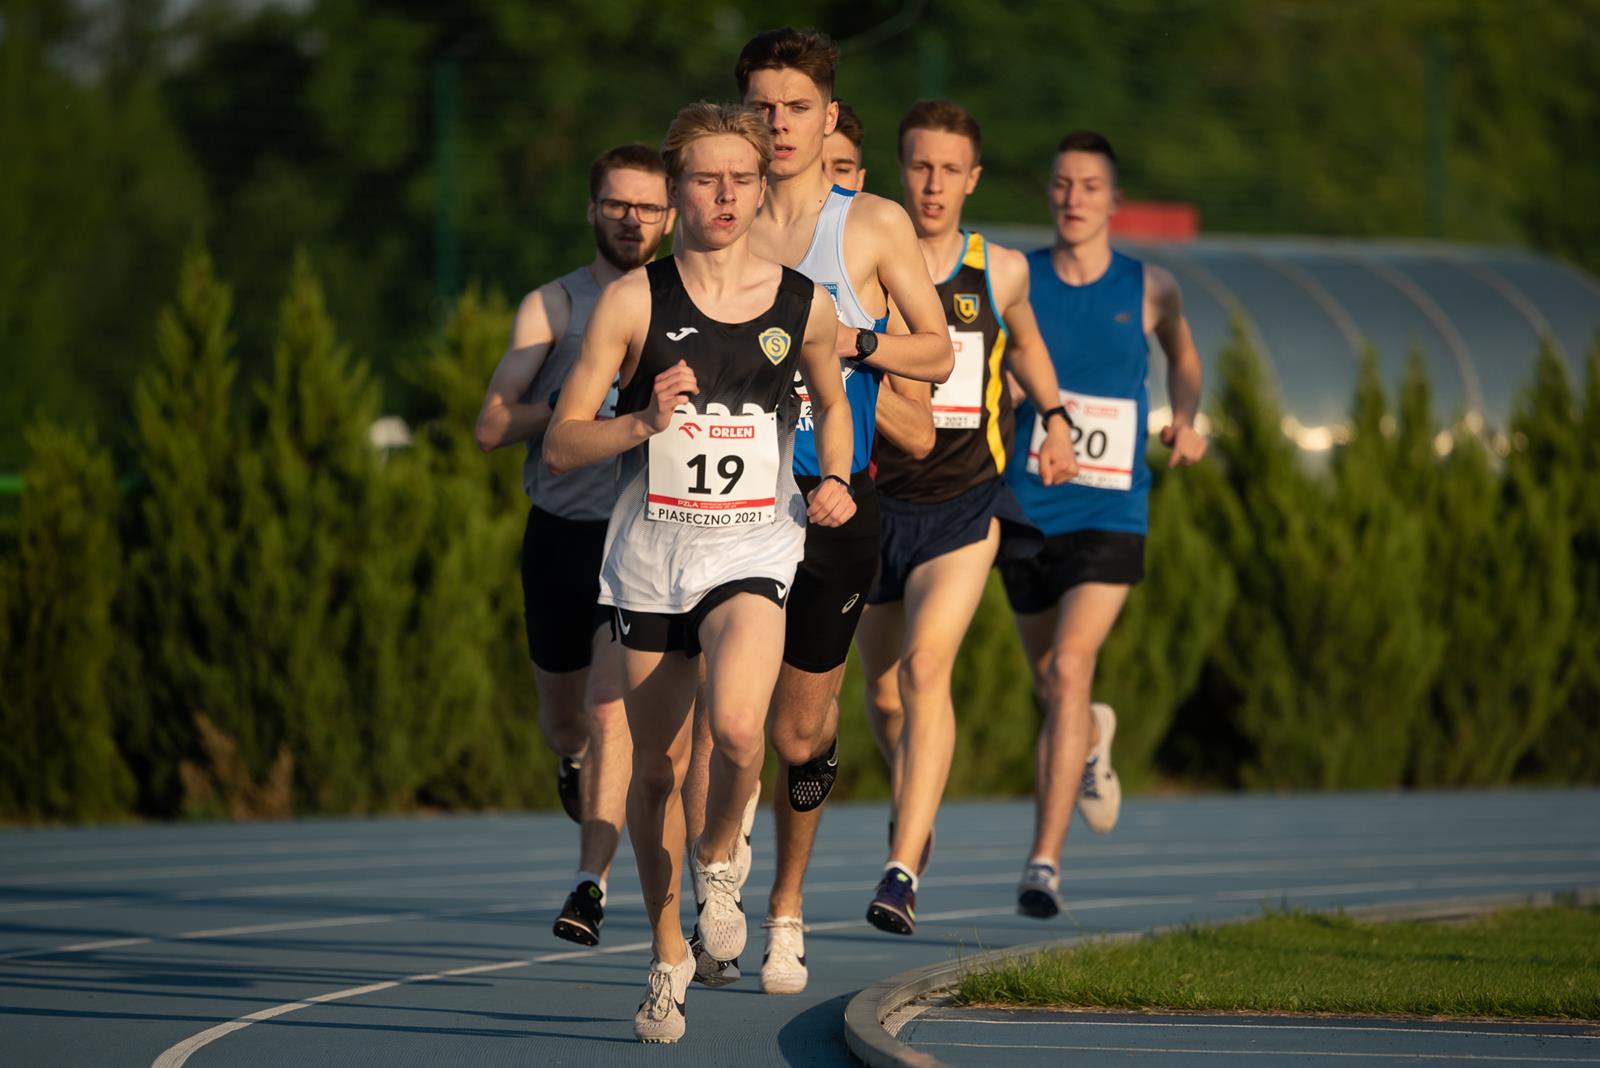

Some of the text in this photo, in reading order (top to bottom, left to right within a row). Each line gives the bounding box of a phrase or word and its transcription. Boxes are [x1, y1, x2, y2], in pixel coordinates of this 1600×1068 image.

[711, 427, 753, 438] ORLEN
[686, 453, 745, 495] 19
[658, 508, 762, 525] PIASECZNO 2021
